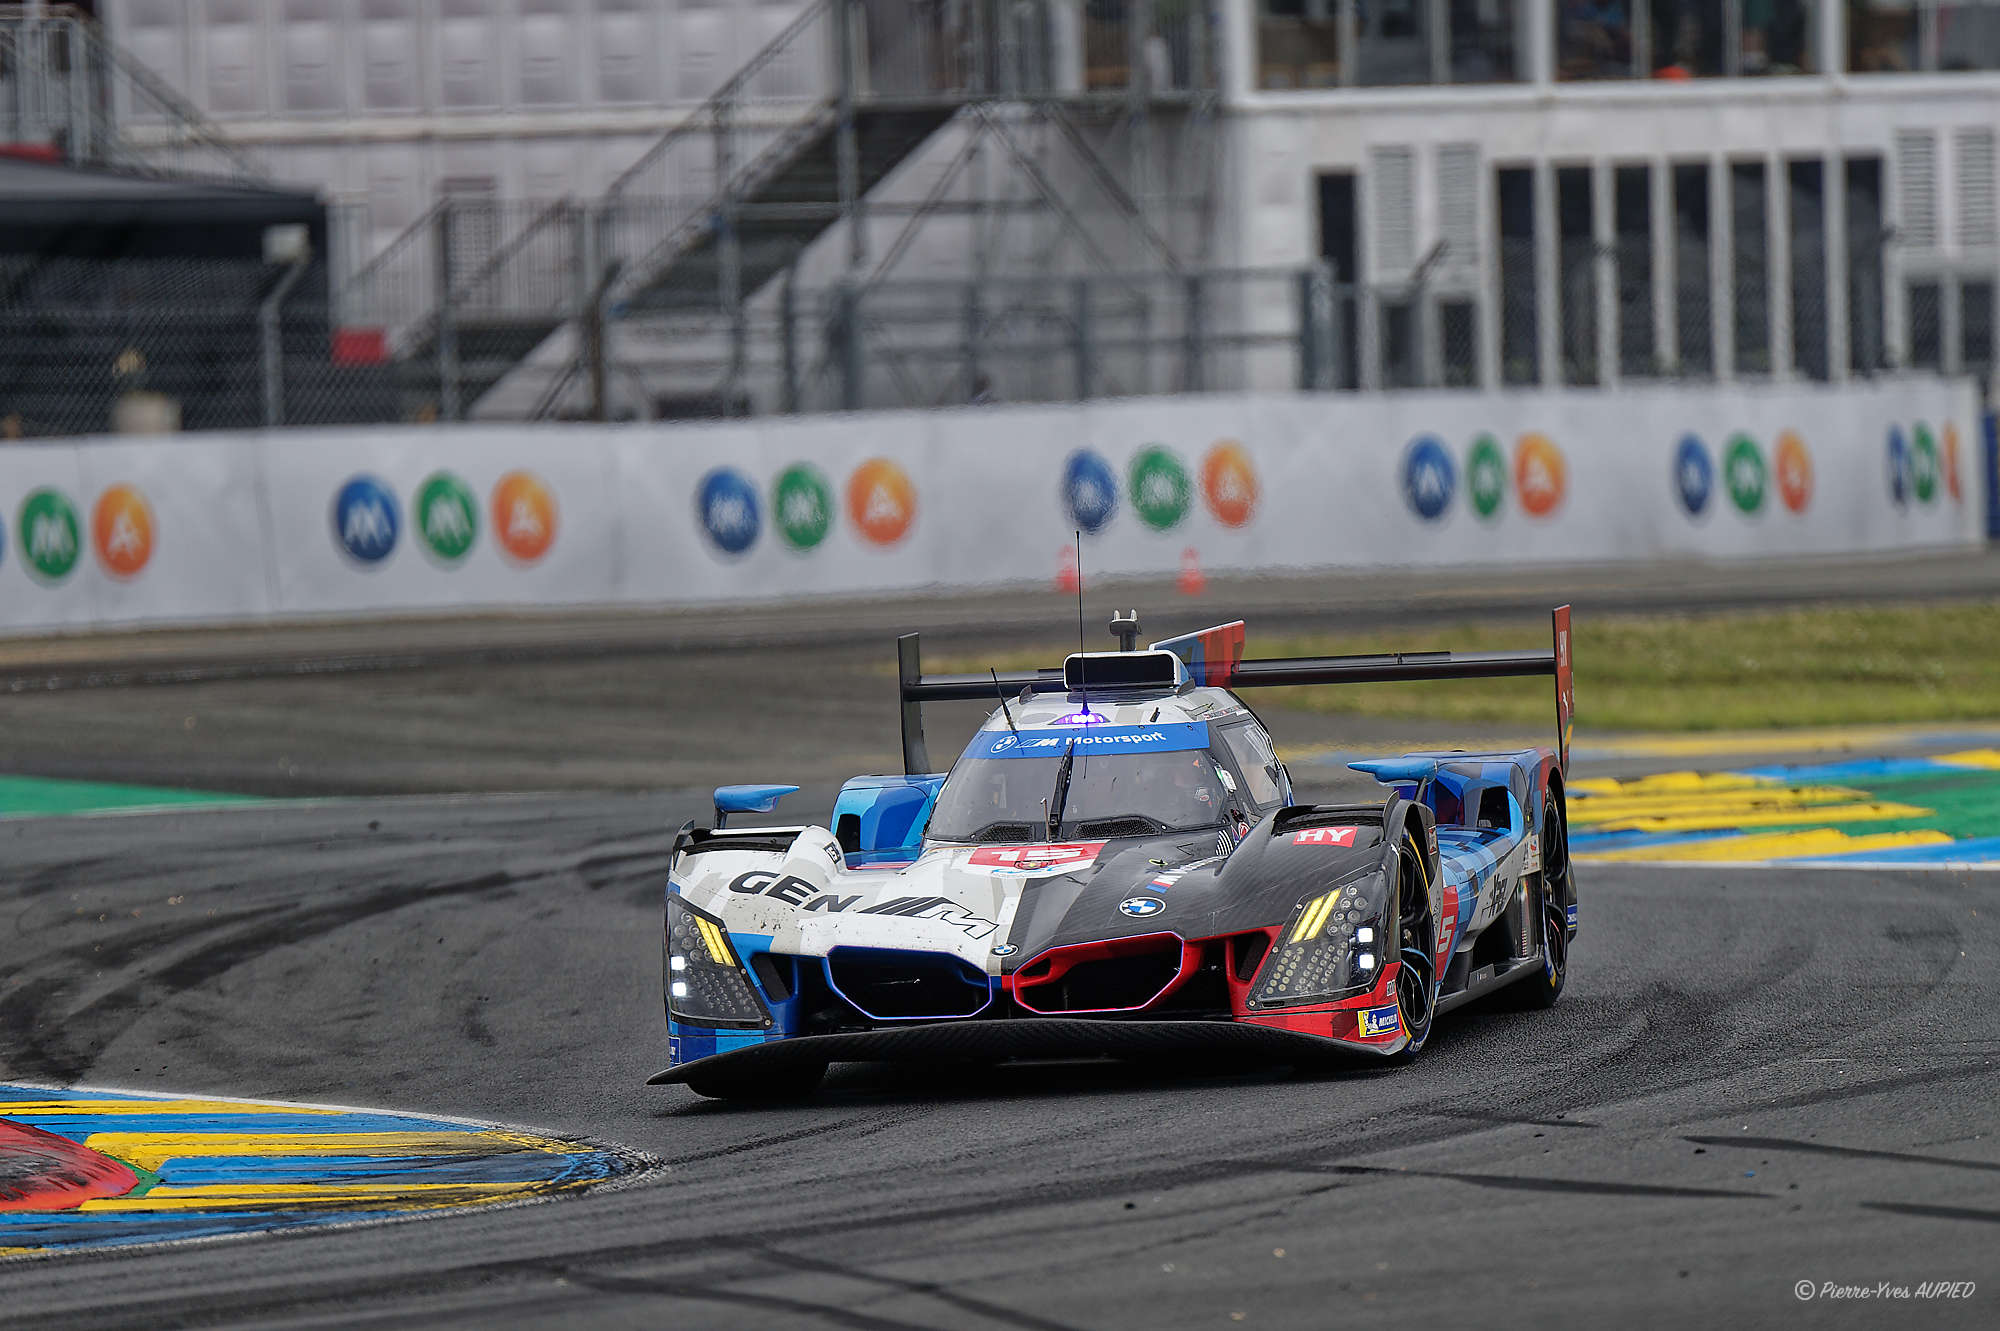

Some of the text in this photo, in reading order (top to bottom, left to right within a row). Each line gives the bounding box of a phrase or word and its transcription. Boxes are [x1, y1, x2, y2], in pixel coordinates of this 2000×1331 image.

[1066, 731, 1167, 747] Motorsport
[1296, 829, 1353, 842] HY
[991, 847, 1084, 862] 15
[729, 870, 863, 913] GEN
